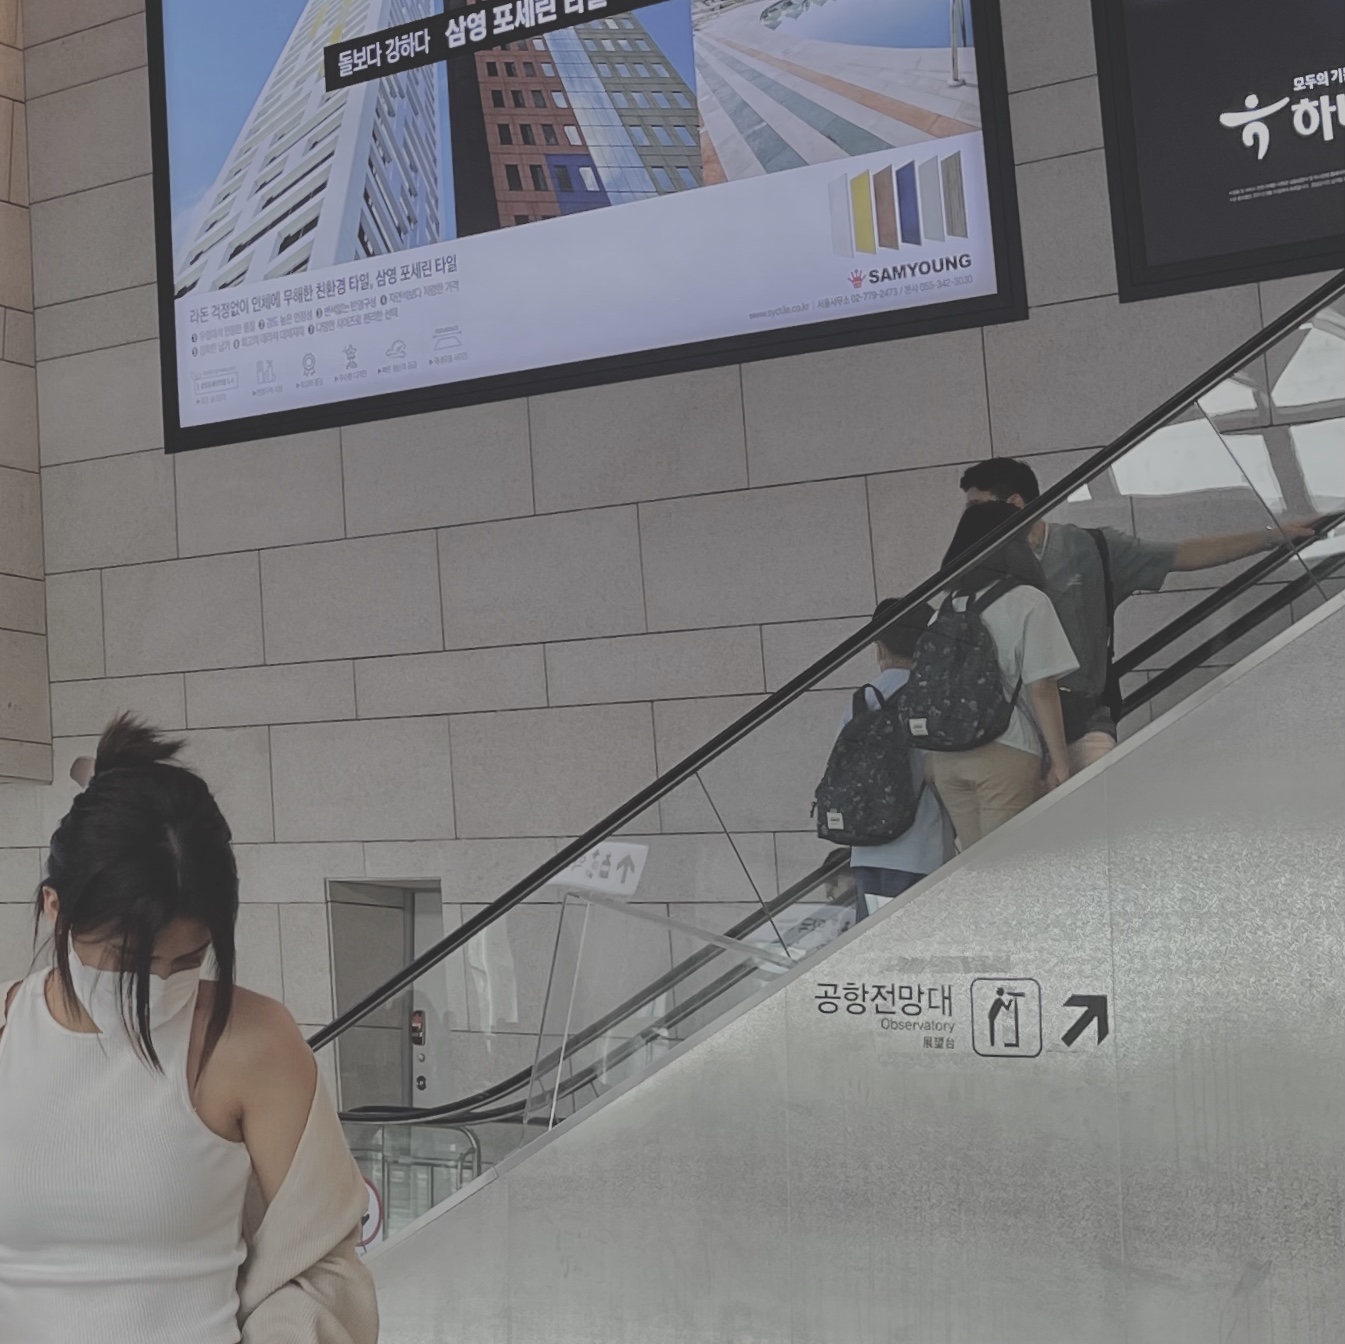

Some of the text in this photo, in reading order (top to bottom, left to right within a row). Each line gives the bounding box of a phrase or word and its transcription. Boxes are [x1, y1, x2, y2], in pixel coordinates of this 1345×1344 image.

[339, 0, 557, 77] 돌보다 강하다 삼영 포세린
[1293, 67, 1345, 91] 모두의 기
[1291, 93, 1345, 141] 하
[869, 253, 972, 284] SAMYOUNG
[189, 308, 209, 325] 라돈
[211, 299, 250, 321] 걱정없이
[283, 285, 313, 307] 무해한
[316, 278, 346, 300] 친환경
[375, 266, 398, 288] 삼영
[400, 259, 433, 282] 포세린
[434, 253, 458, 275] 타일
[814, 982, 953, 1017] 공항전망대
[881, 1018, 955, 1033] Observatory
